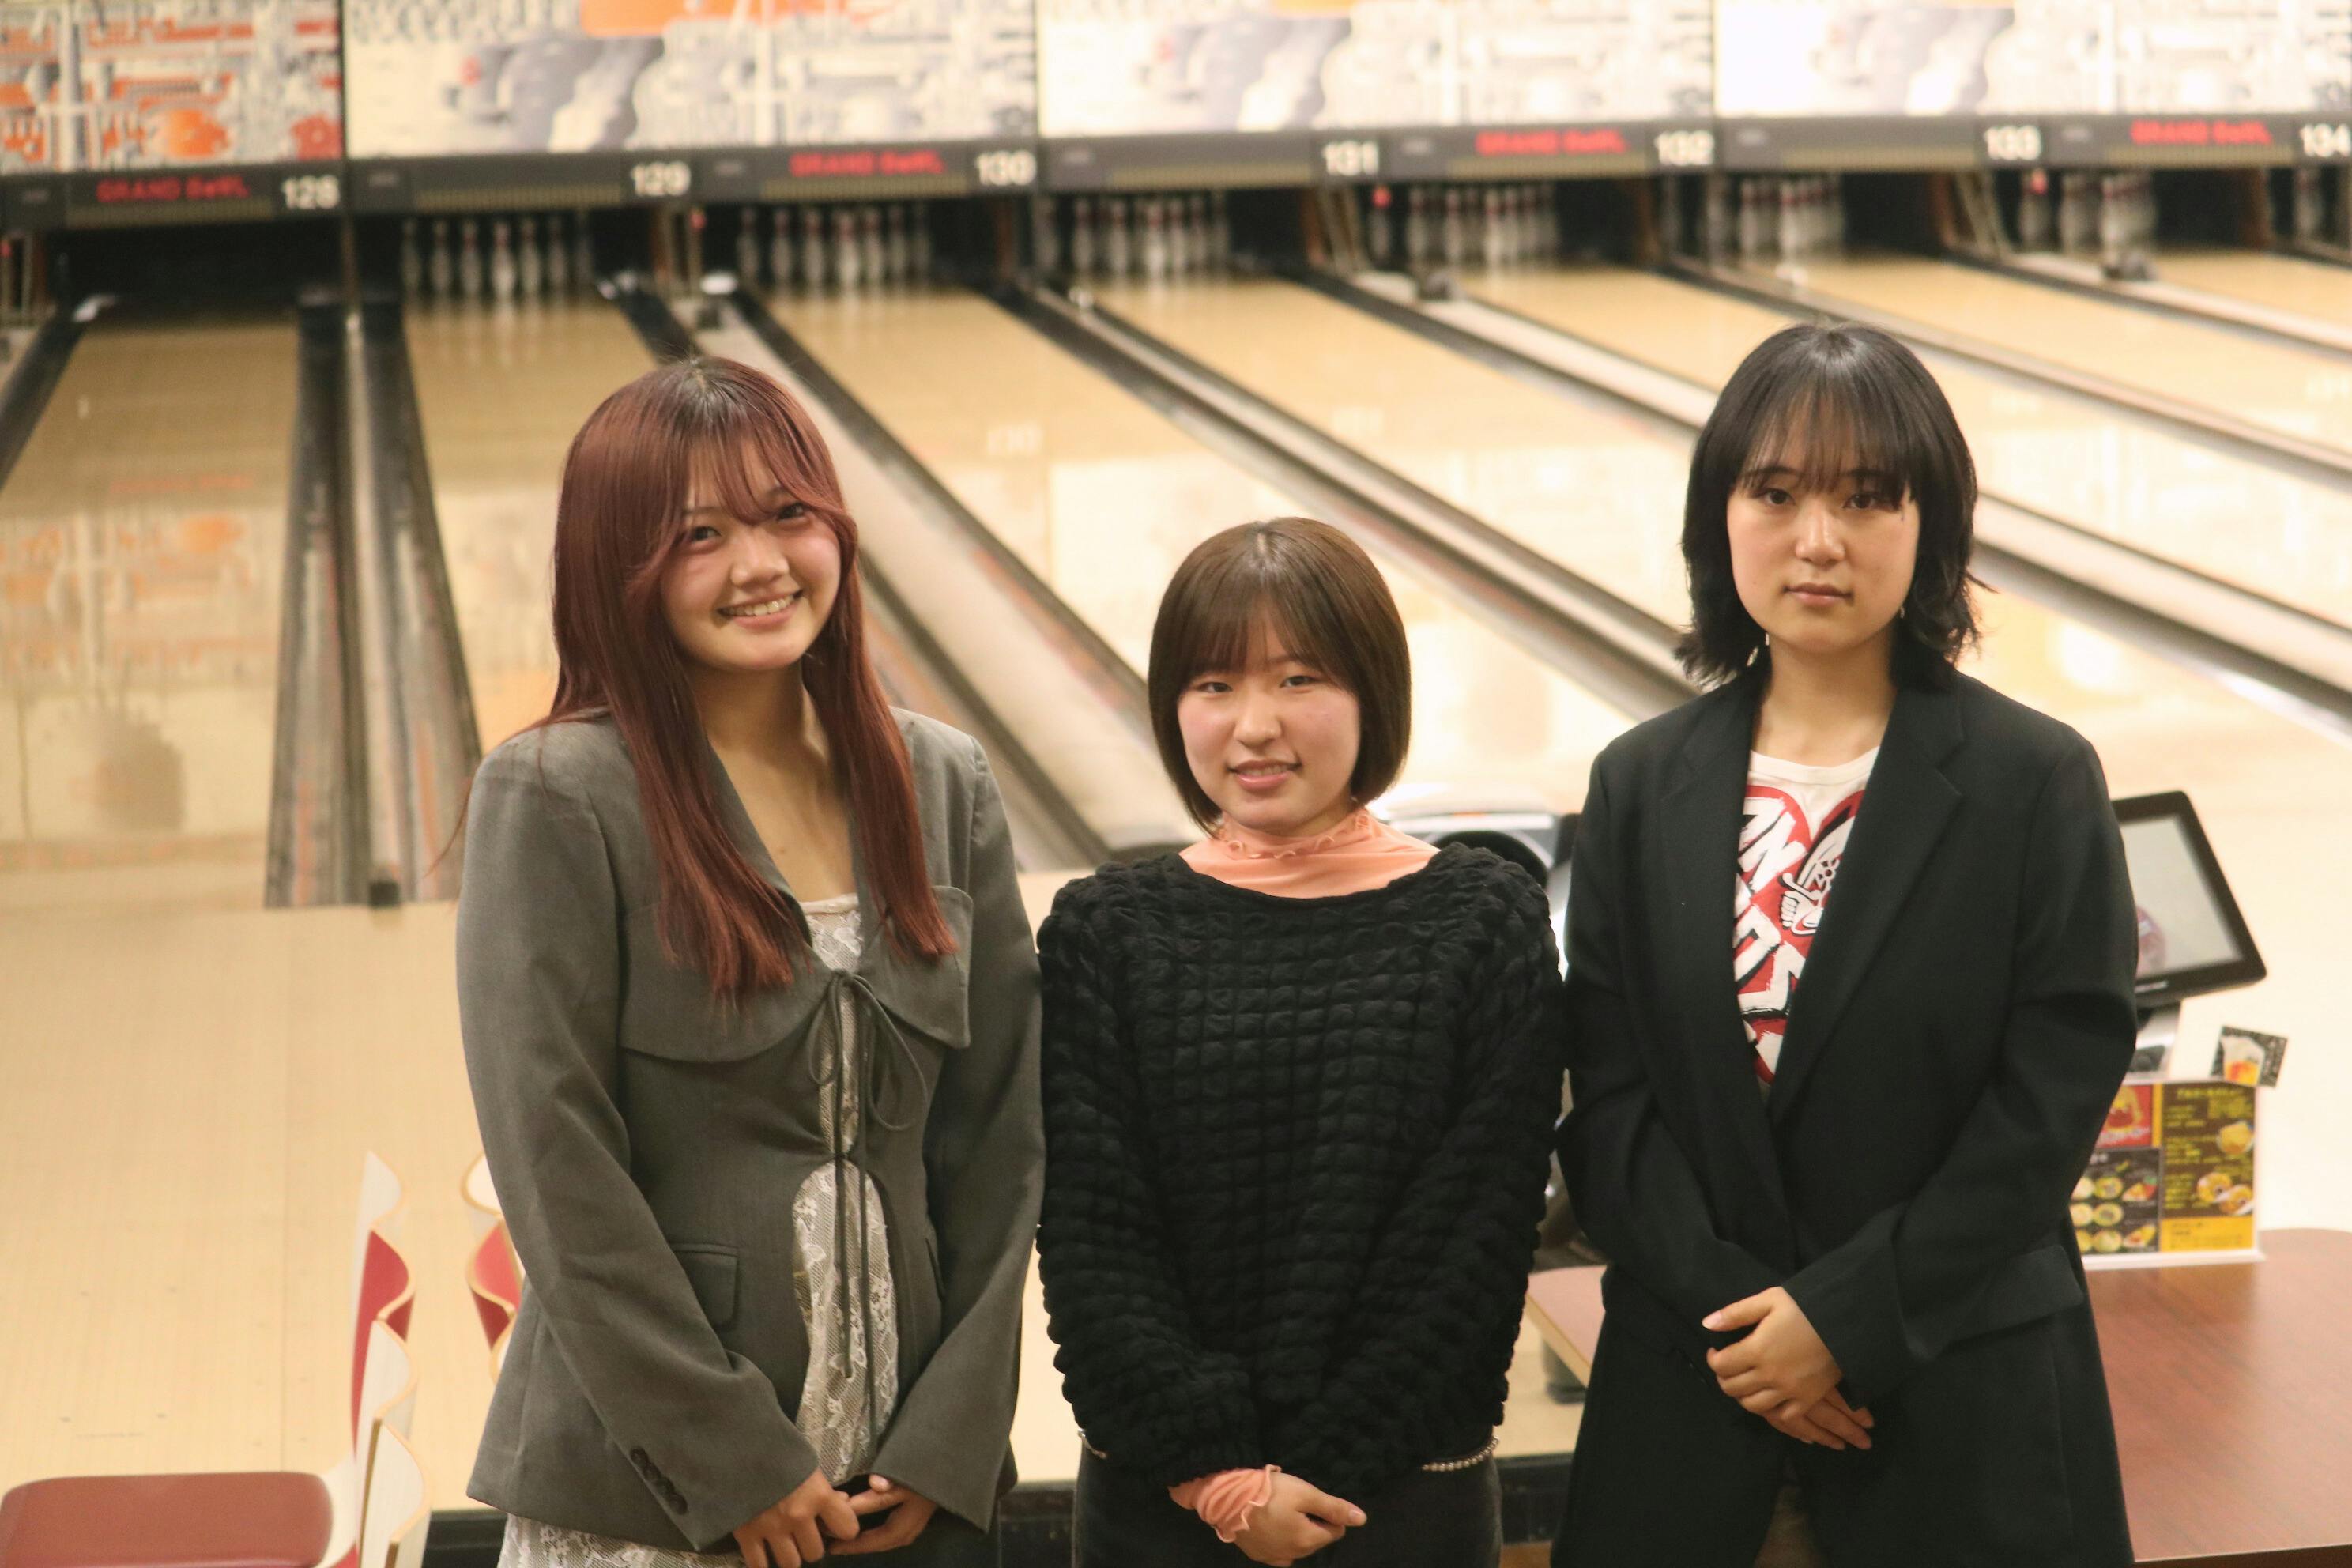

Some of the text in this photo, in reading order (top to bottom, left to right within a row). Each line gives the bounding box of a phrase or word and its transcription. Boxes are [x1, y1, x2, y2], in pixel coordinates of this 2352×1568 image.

[1321, 140, 1379, 175] 131
[1654, 129, 1714, 165] 132
[2299, 122, 2352, 158] 134
[975, 151, 1036, 186] 130
[96, 178, 183, 203] GRAND
